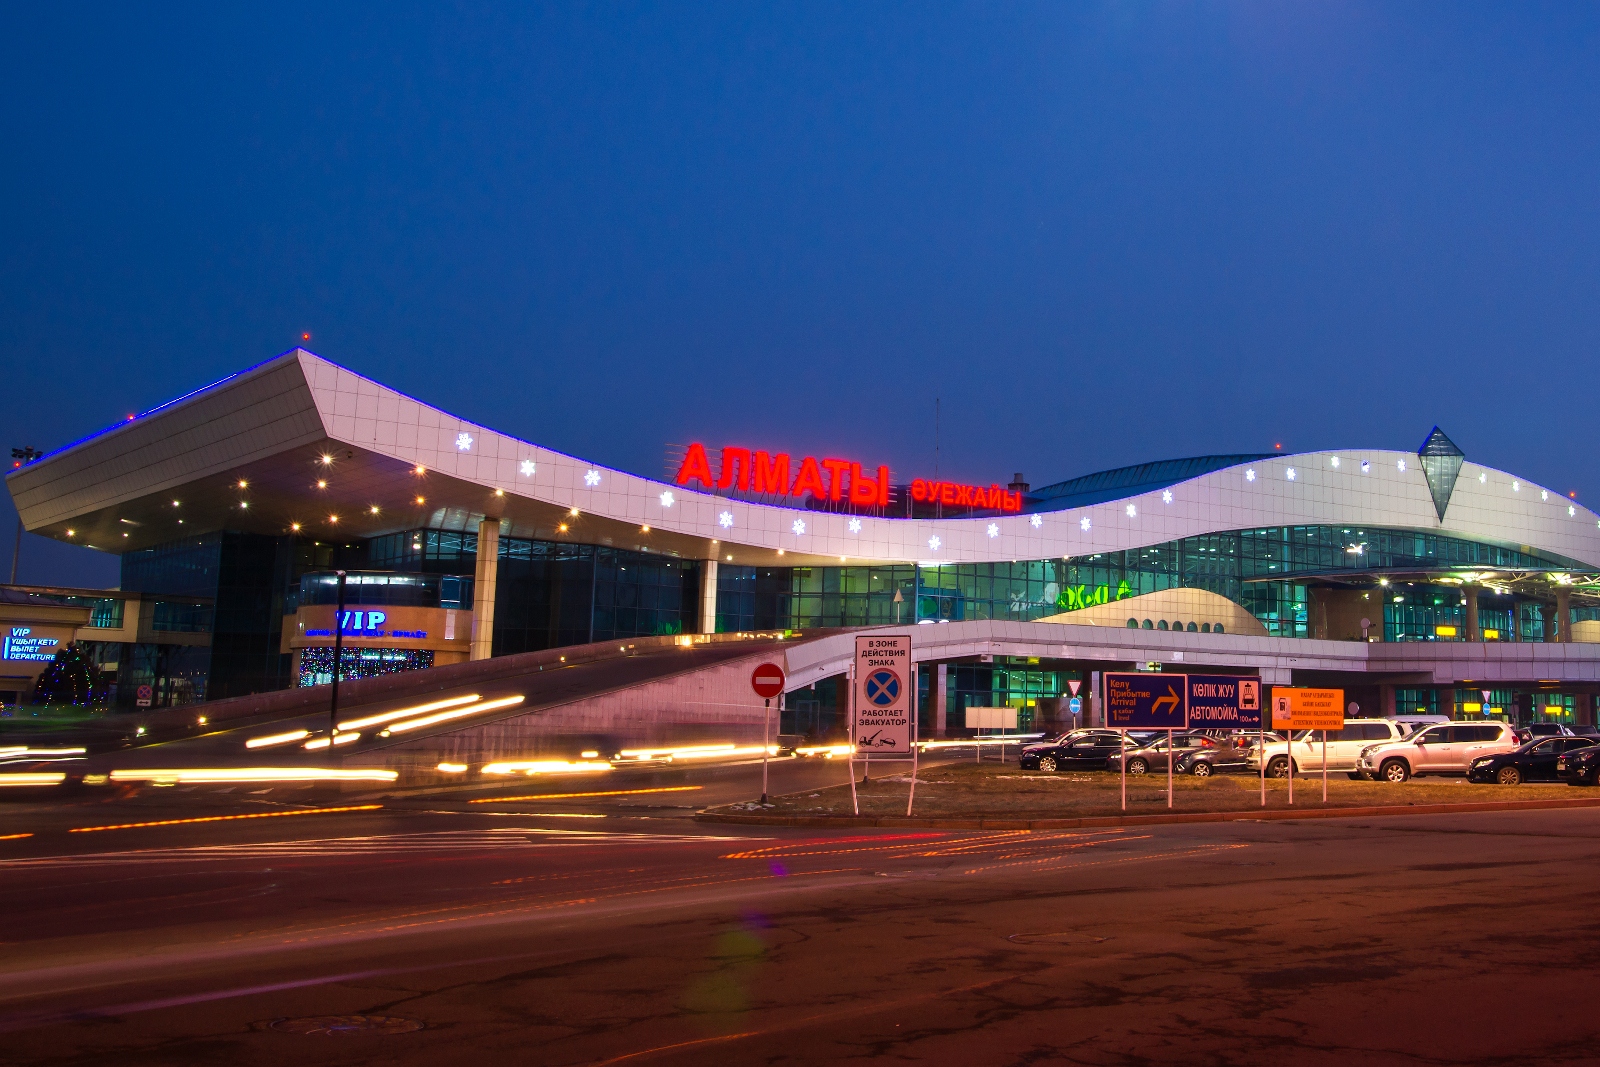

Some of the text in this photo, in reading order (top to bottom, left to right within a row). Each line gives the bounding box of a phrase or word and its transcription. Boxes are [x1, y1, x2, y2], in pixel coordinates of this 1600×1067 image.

[676, 442, 889, 506] АЛМАТЫ
[911, 479, 1021, 512] ӘУЕЖАЙЫ
[335, 610, 386, 630] VIP
[12, 627, 31, 637] VIP
[37, 638, 59, 646] КЕТУ
[875, 640, 898, 648] ЗОНЕ
[10, 645, 40, 653] ВЫЛЕТ
[861, 649, 906, 658] ДЕЙСТВИЯ
[9, 653, 56, 661] DEPARTURE
[1110, 679, 1130, 689] Келу
[1110, 688, 1151, 698] Прибытие
[1192, 683, 1235, 698] КӨЛІК ЖУУ
[1110, 697, 1137, 706] Arrival
[862, 709, 904, 717] РАБОТАЕТ
[1112, 709, 1118, 721] 1
[1190, 703, 1239, 720] АВТОМОЙКА
[859, 718, 907, 726] ЭВАКУАТОР
